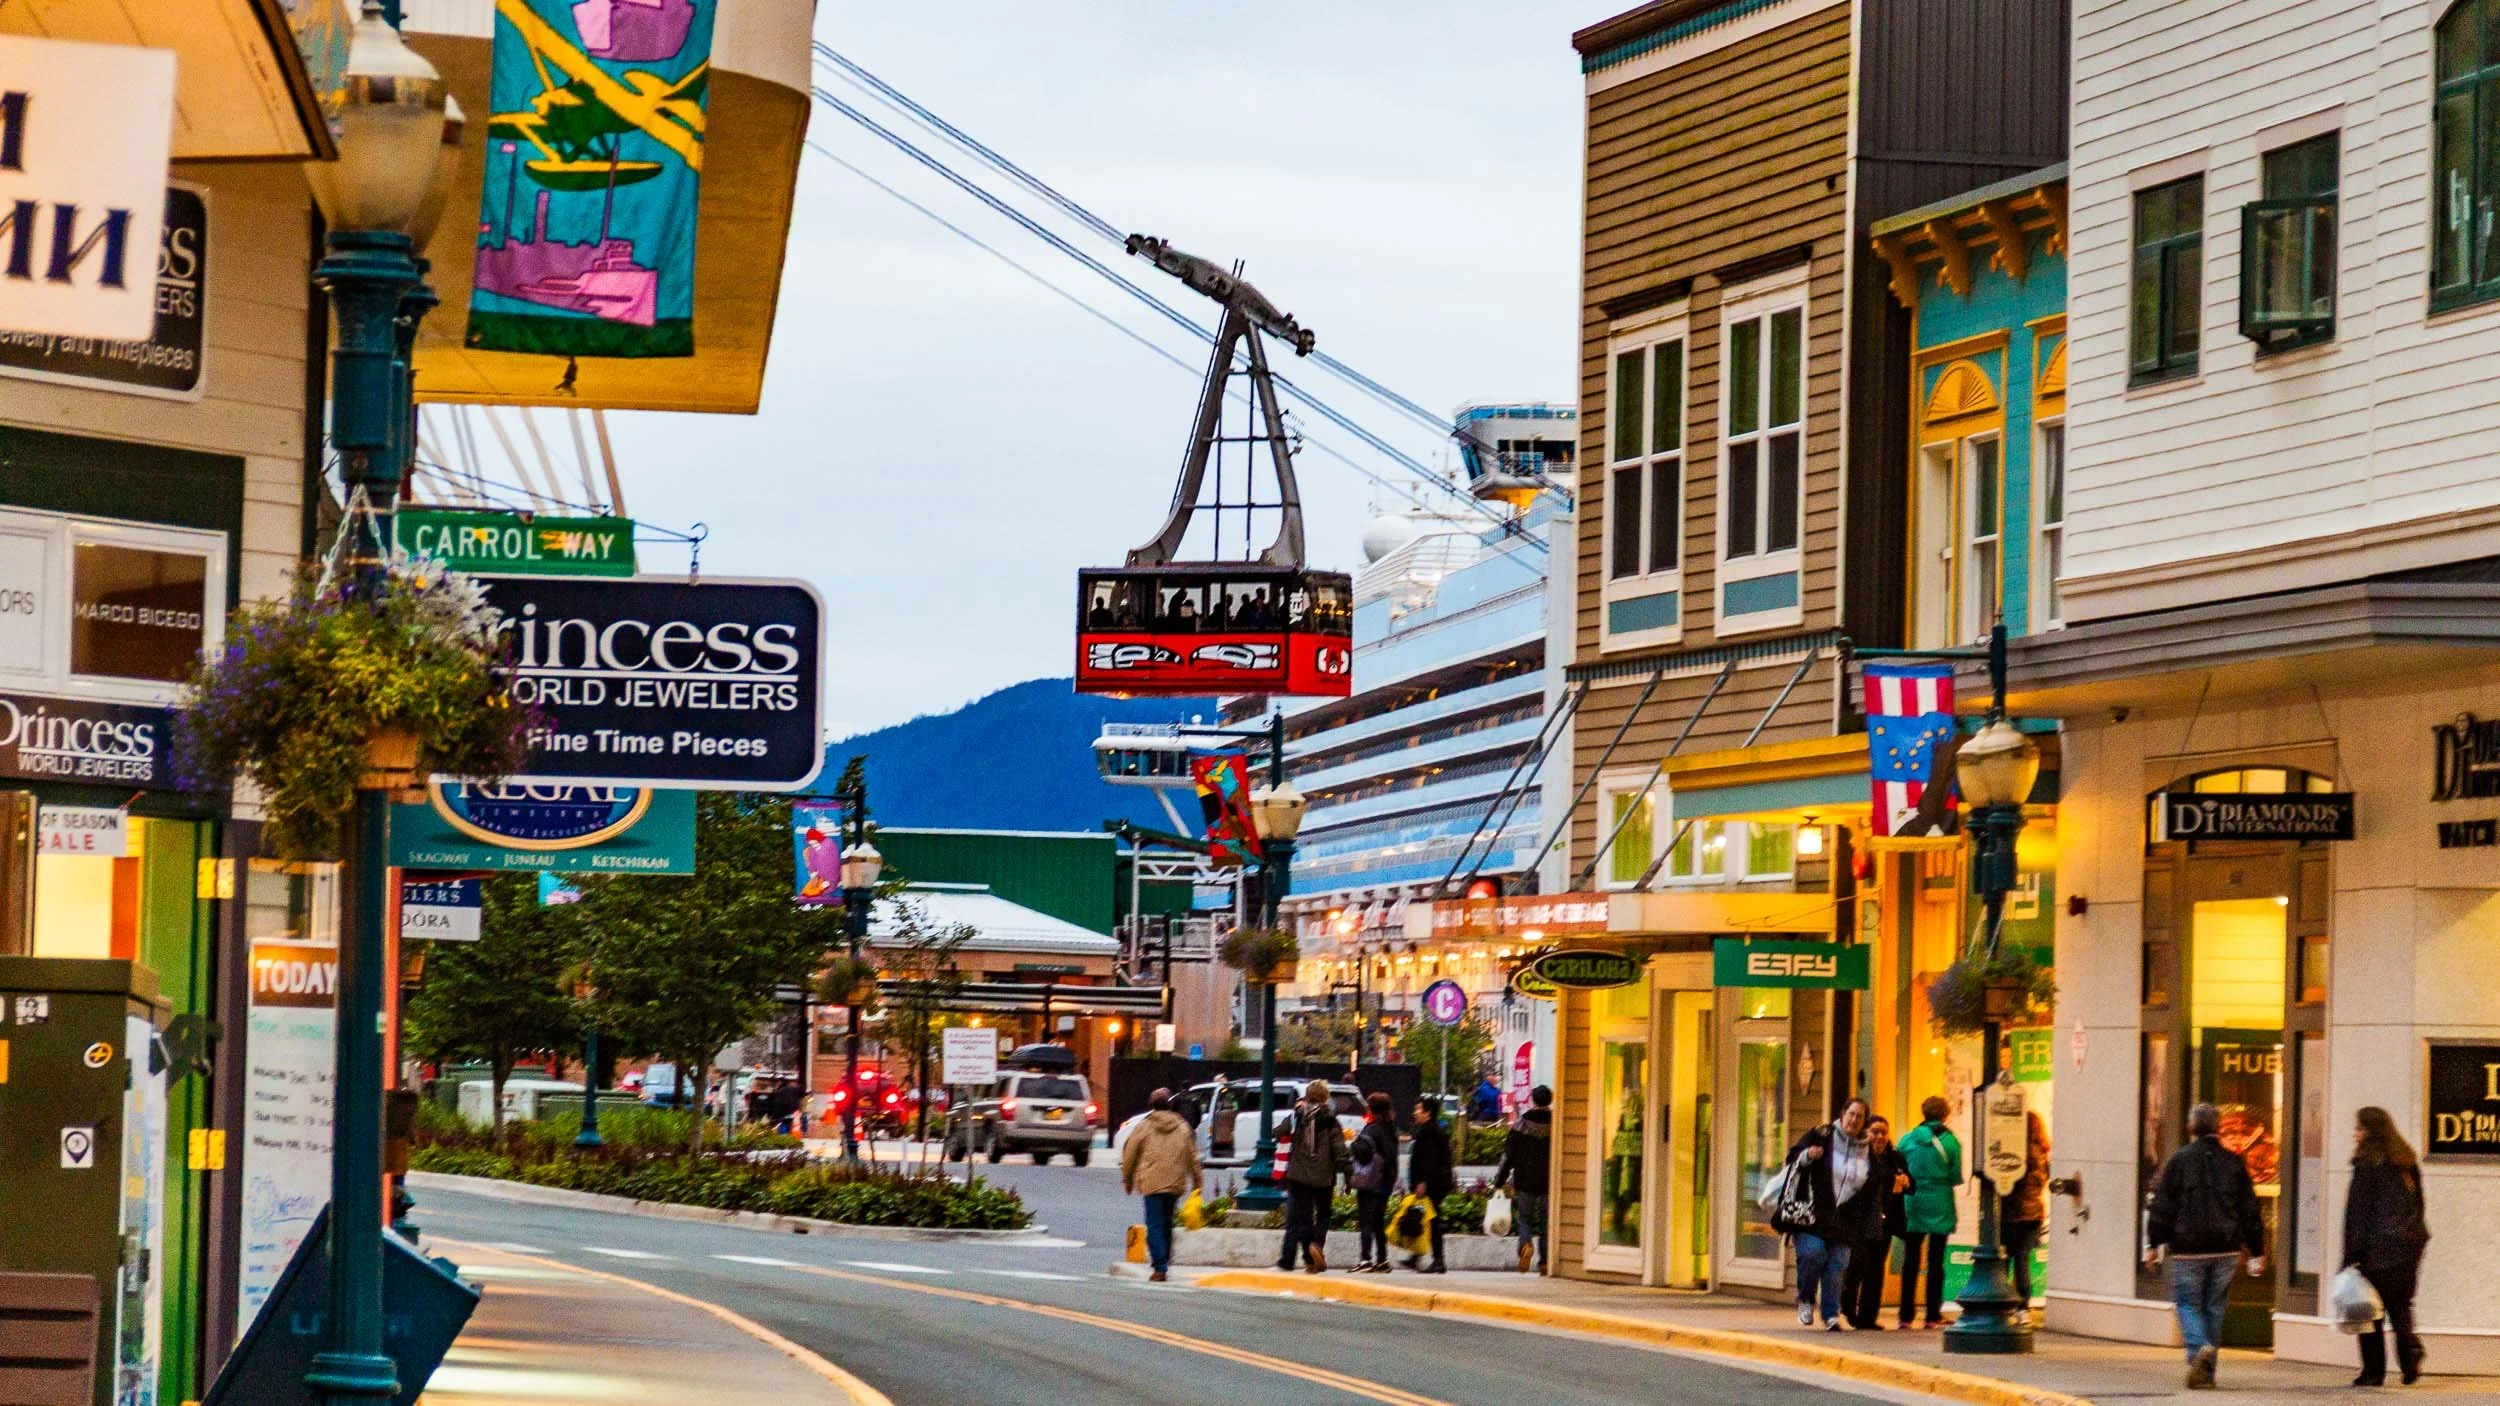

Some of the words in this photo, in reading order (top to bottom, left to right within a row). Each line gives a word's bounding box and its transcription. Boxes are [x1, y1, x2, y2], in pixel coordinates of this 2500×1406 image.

[416, 525, 543, 560] CARROL
[563, 531, 614, 560] WAY
[75, 603, 134, 623] MARCO
[137, 607, 201, 630] BICEGO
[488, 602, 799, 674] rincess
[511, 677, 606, 708] ORLD
[615, 679, 798, 712] JEWELERS
[527, 729, 588, 753] Fine
[594, 730, 664, 754] Time
[672, 731, 768, 758] Pieces
[18, 752, 74, 775] WORLD
[75, 758, 153, 781] JEWELERS
[63, 813, 118, 830] SEASON
[2219, 803, 2340, 821] DIAMONDS
[2219, 821, 2339, 833] INTERNATIONAL
[408, 851, 471, 864] SKAGWAY
[503, 854, 556, 867] JUNEAU
[591, 855, 670, 868] KETCHIKAN
[255, 959, 337, 995] TODAY
[1747, 953, 1838, 978] EFFY
